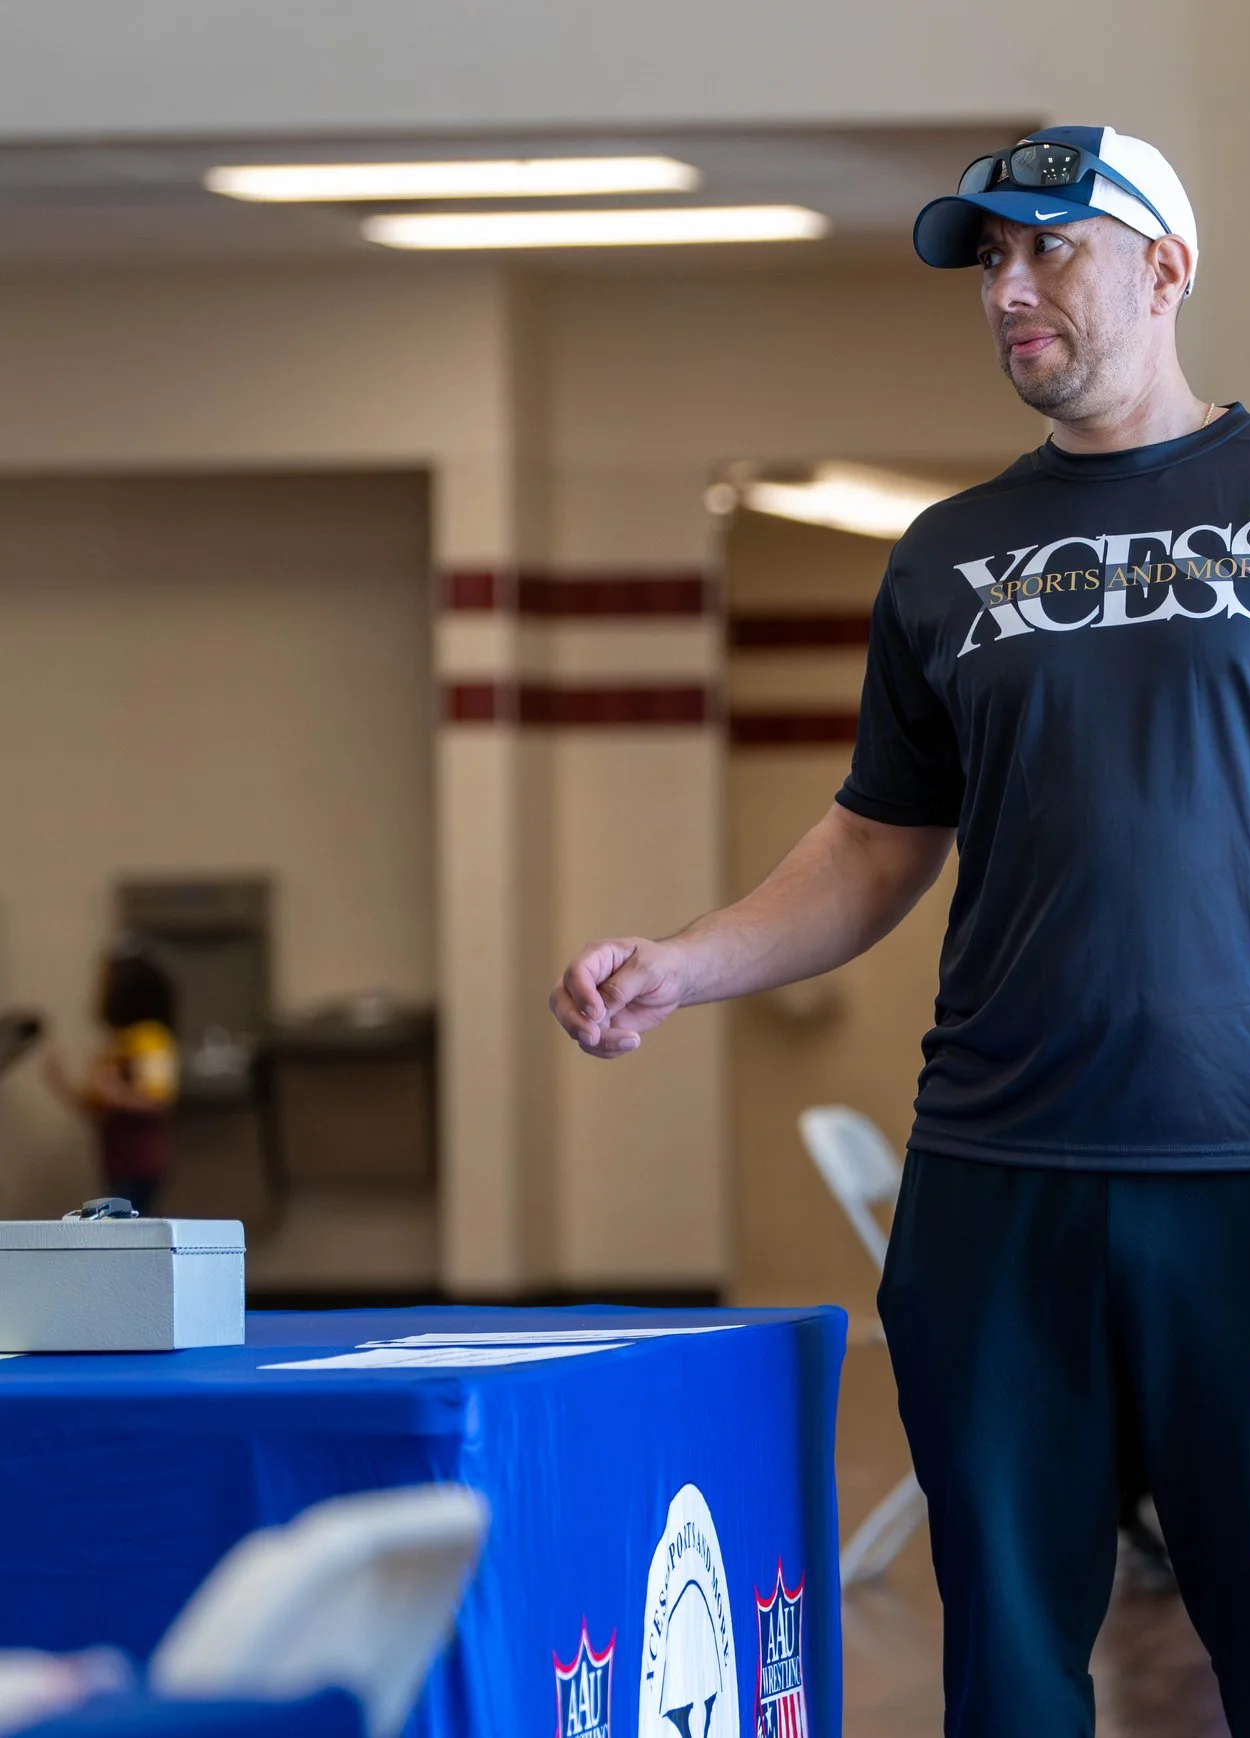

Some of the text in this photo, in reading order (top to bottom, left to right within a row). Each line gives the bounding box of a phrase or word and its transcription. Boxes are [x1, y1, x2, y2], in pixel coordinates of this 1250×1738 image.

[988, 569, 1100, 606] SPORTS
[1107, 562, 1177, 589] AND
[766, 1597, 795, 1664] AAU
[566, 1660, 603, 1737] AAU
[762, 1656, 801, 1697] WRESTLING
